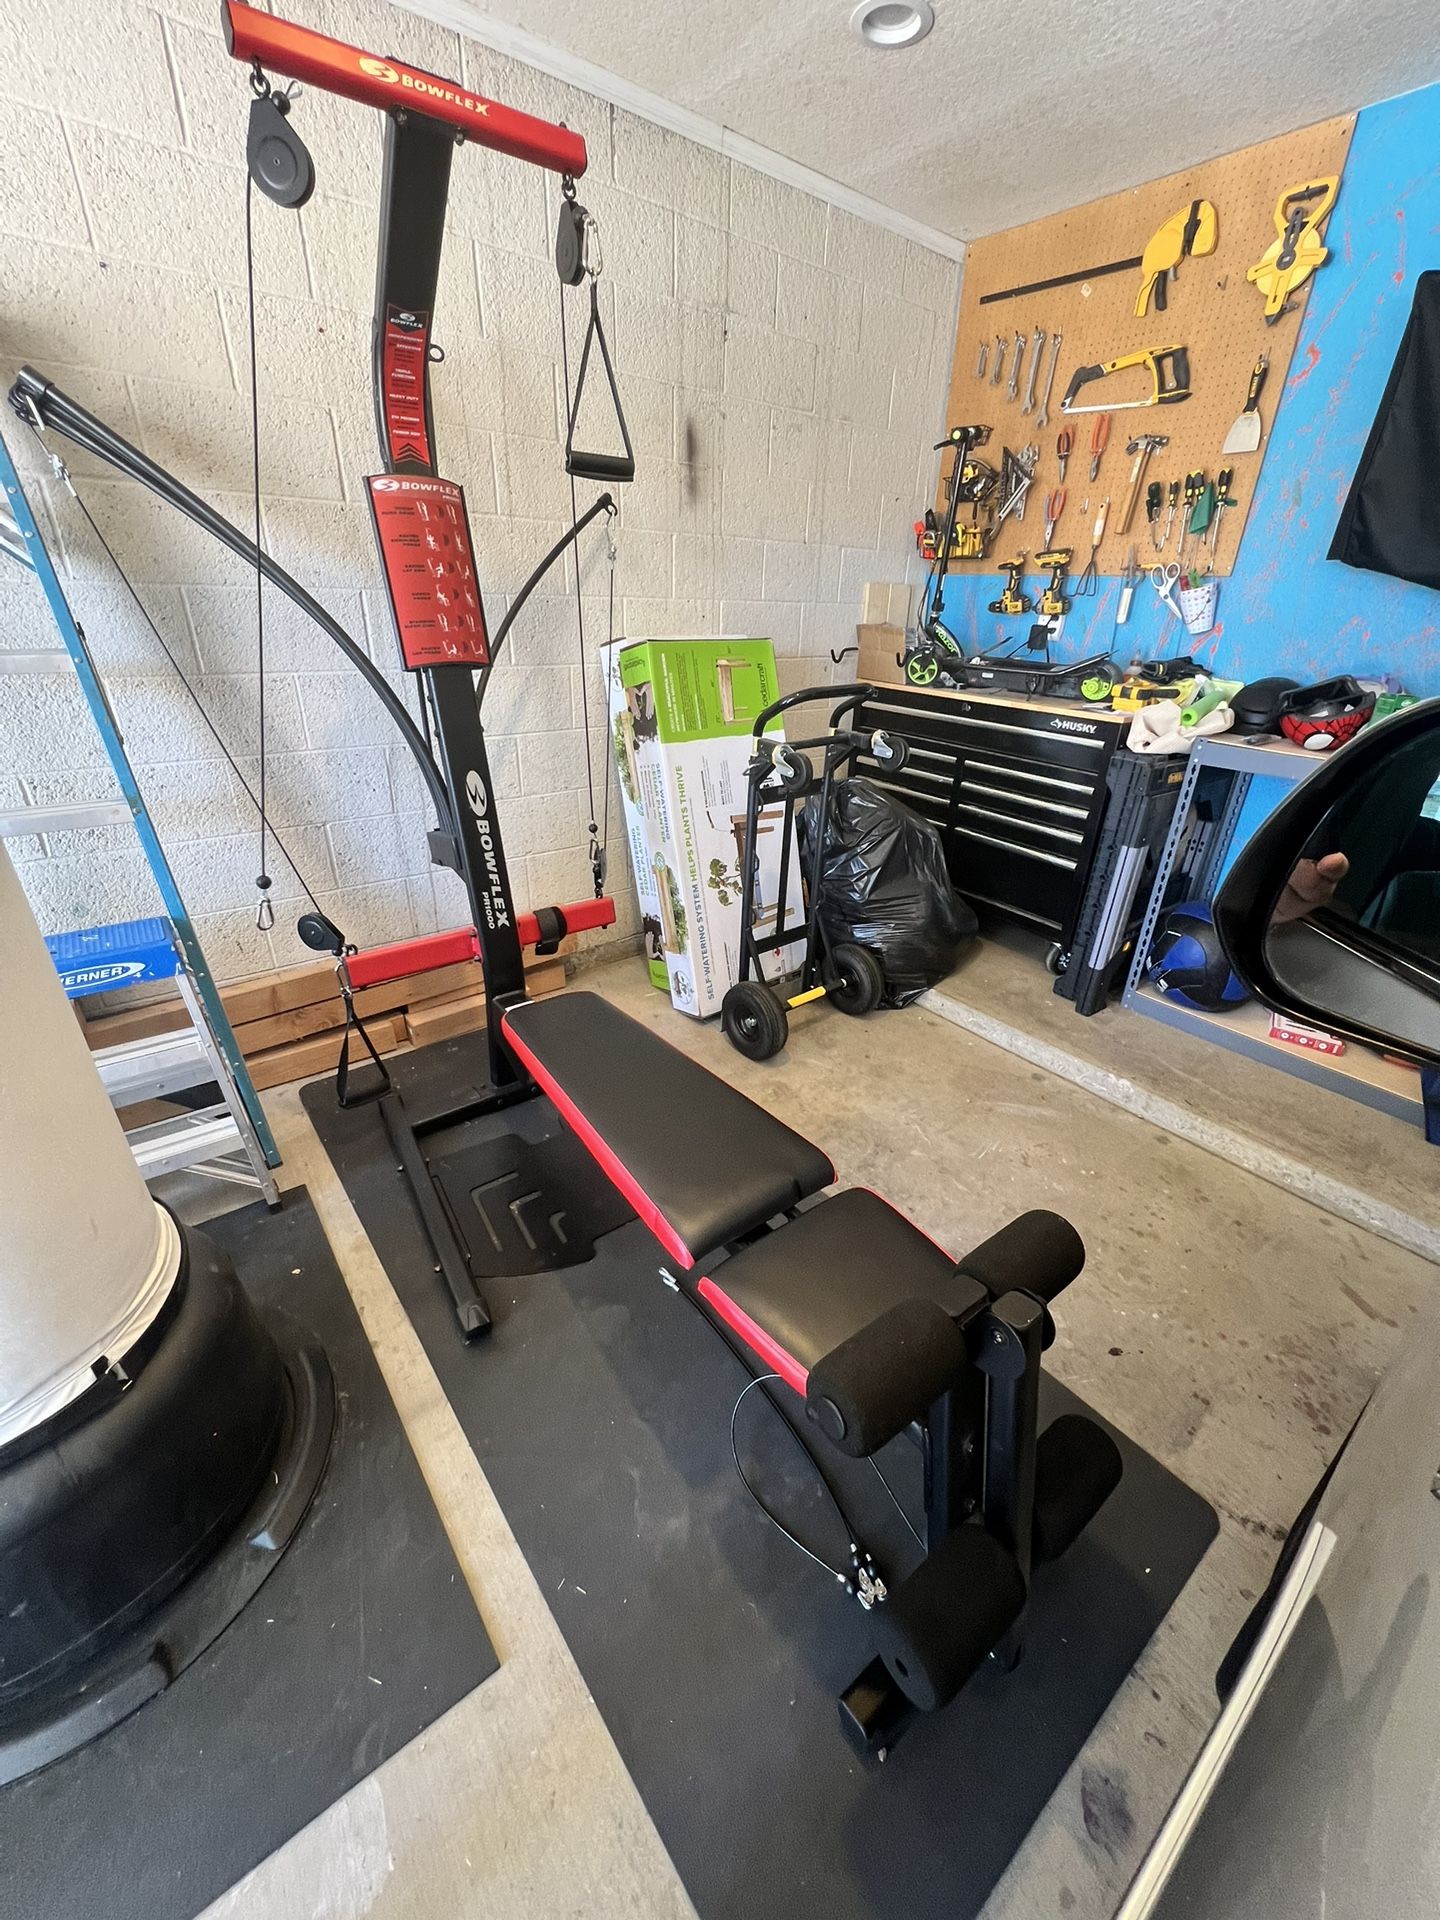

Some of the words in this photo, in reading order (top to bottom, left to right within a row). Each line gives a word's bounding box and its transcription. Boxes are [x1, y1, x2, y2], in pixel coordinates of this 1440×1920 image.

[401, 73, 491, 117] BOWFLEX
[401, 481, 460, 497] BOWFLEX
[1061, 720, 1098, 734] HUSKY
[675, 765, 686, 804] THRIVE
[681, 807, 692, 848] PLANTS
[476, 819, 510, 928] BOWFLEX
[686, 849, 698, 881] HELPS
[481, 891, 495, 930] PR1000
[692, 884, 703, 923] SYSTEM
[60, 967, 122, 986] ERNER
[698, 924, 715, 1000] SELF-WATERING
